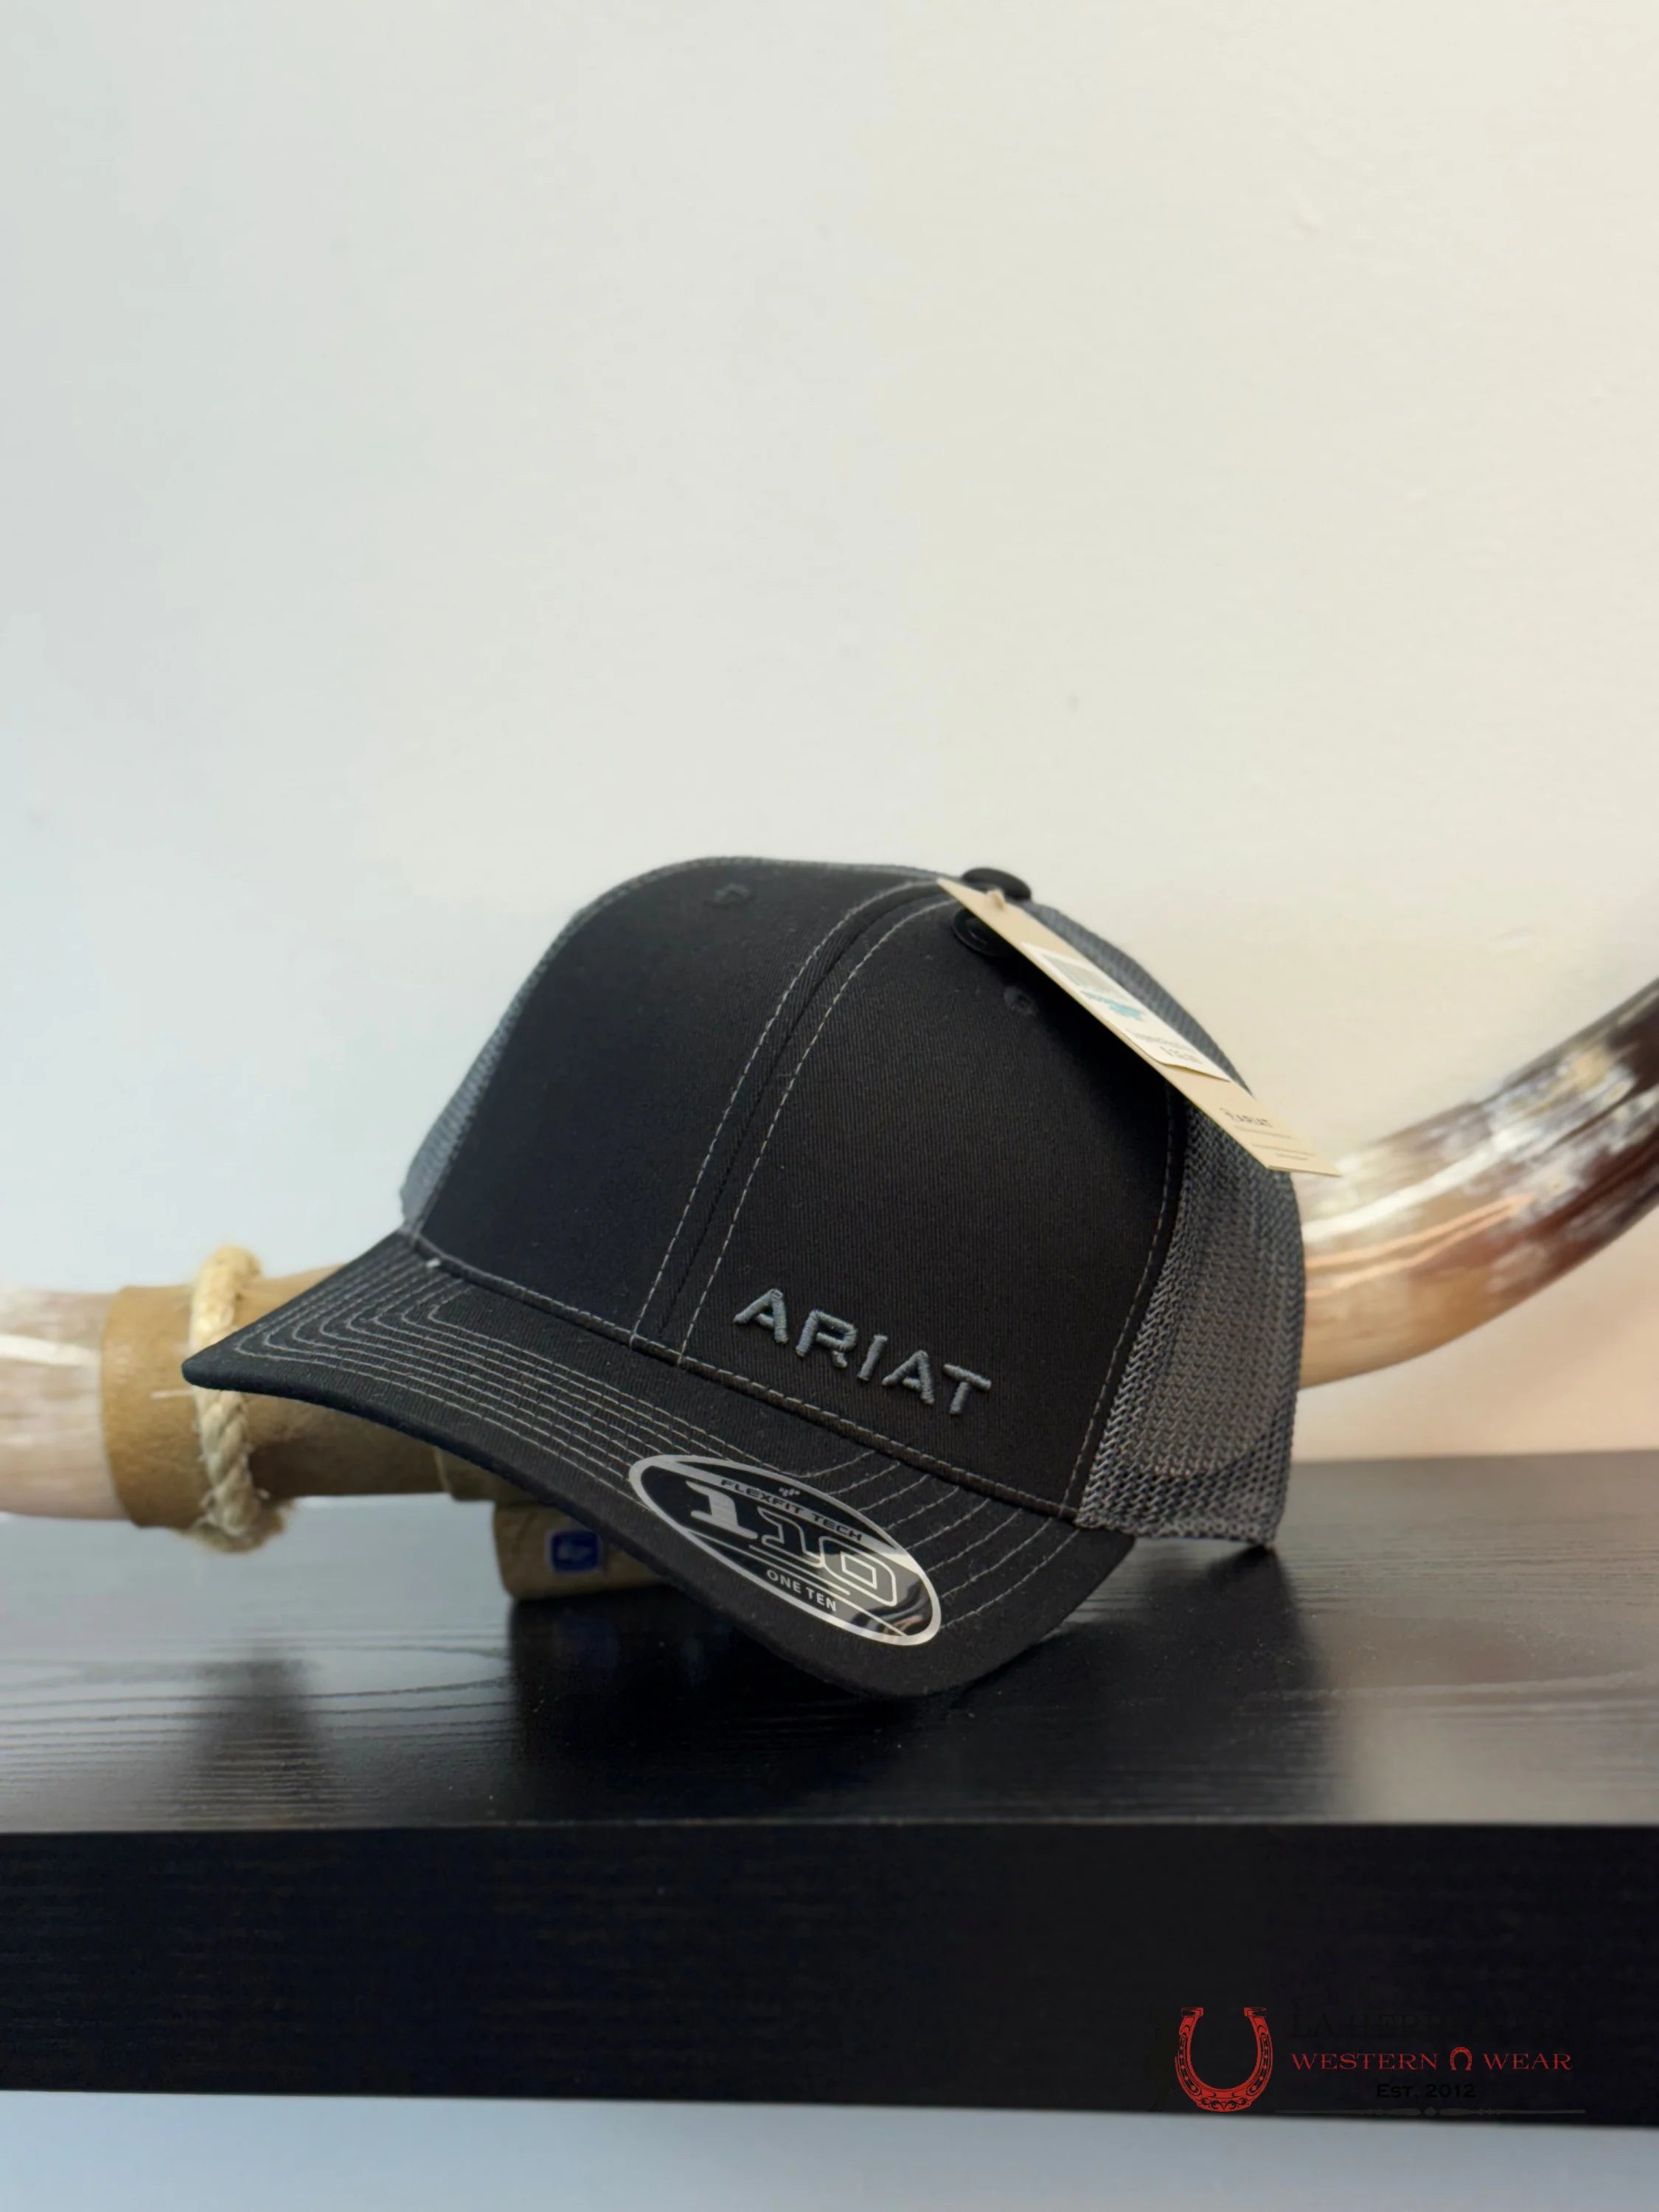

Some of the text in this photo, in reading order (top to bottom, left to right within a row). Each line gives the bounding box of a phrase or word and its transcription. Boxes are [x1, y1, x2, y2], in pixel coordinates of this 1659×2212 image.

[733, 1288, 992, 1415] ARIAT
[686, 1480, 897, 1607] 110
[720, 1478, 863, 1542] FLEXFIT TECH
[766, 1569, 837, 1613] ONE TEN
